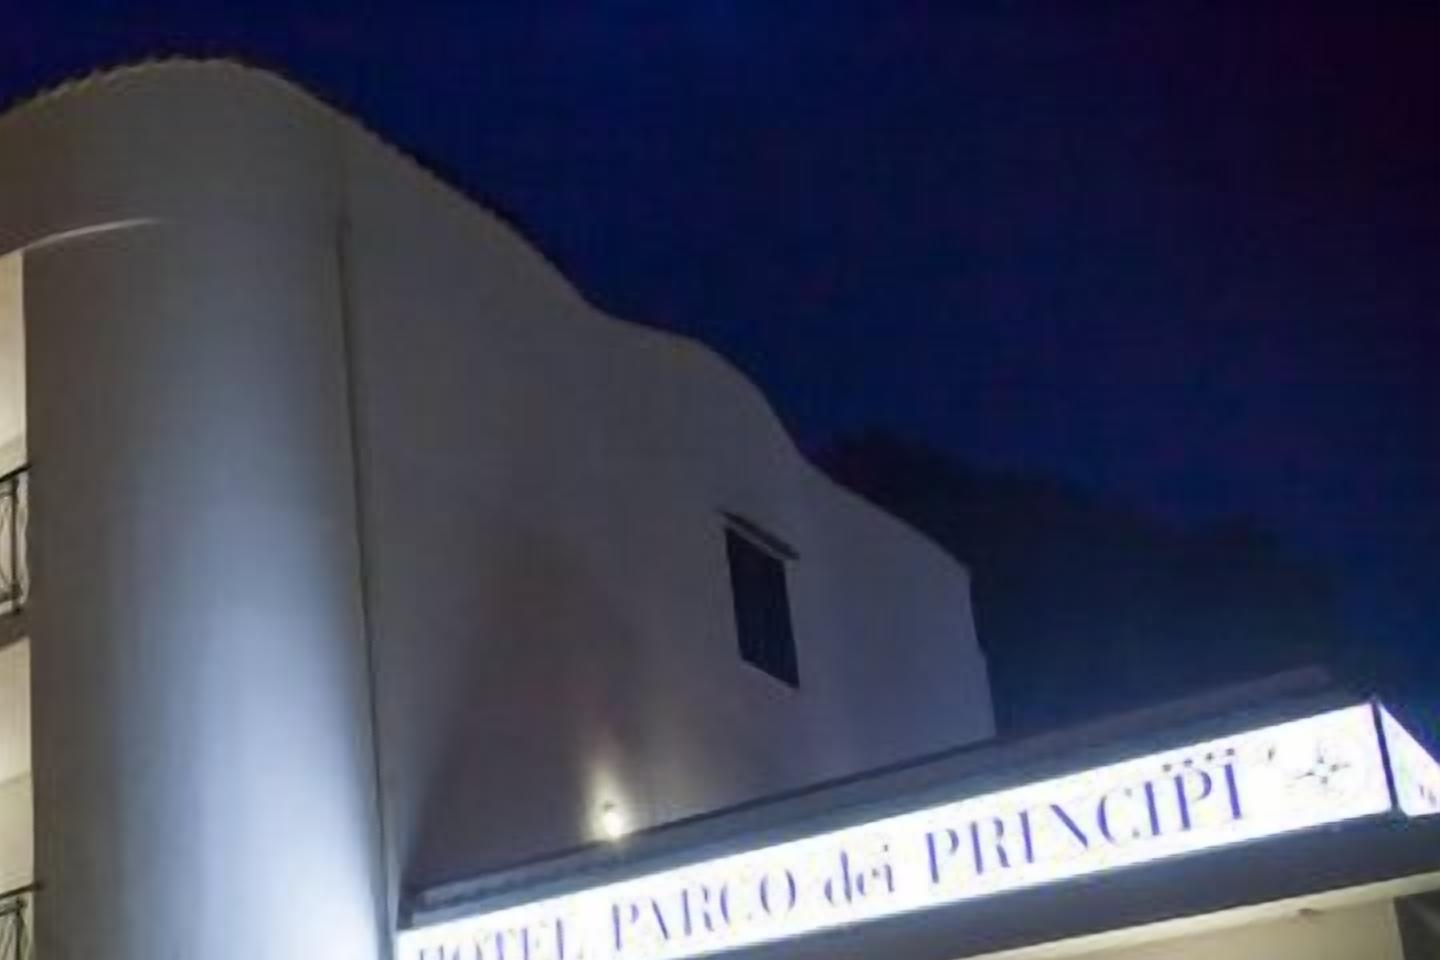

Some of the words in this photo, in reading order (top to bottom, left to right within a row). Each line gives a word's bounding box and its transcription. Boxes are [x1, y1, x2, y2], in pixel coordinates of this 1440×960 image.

[610, 867, 798, 952] PARCO
[822, 843, 897, 907] dei
[924, 761, 1244, 884] PRINCIPI
